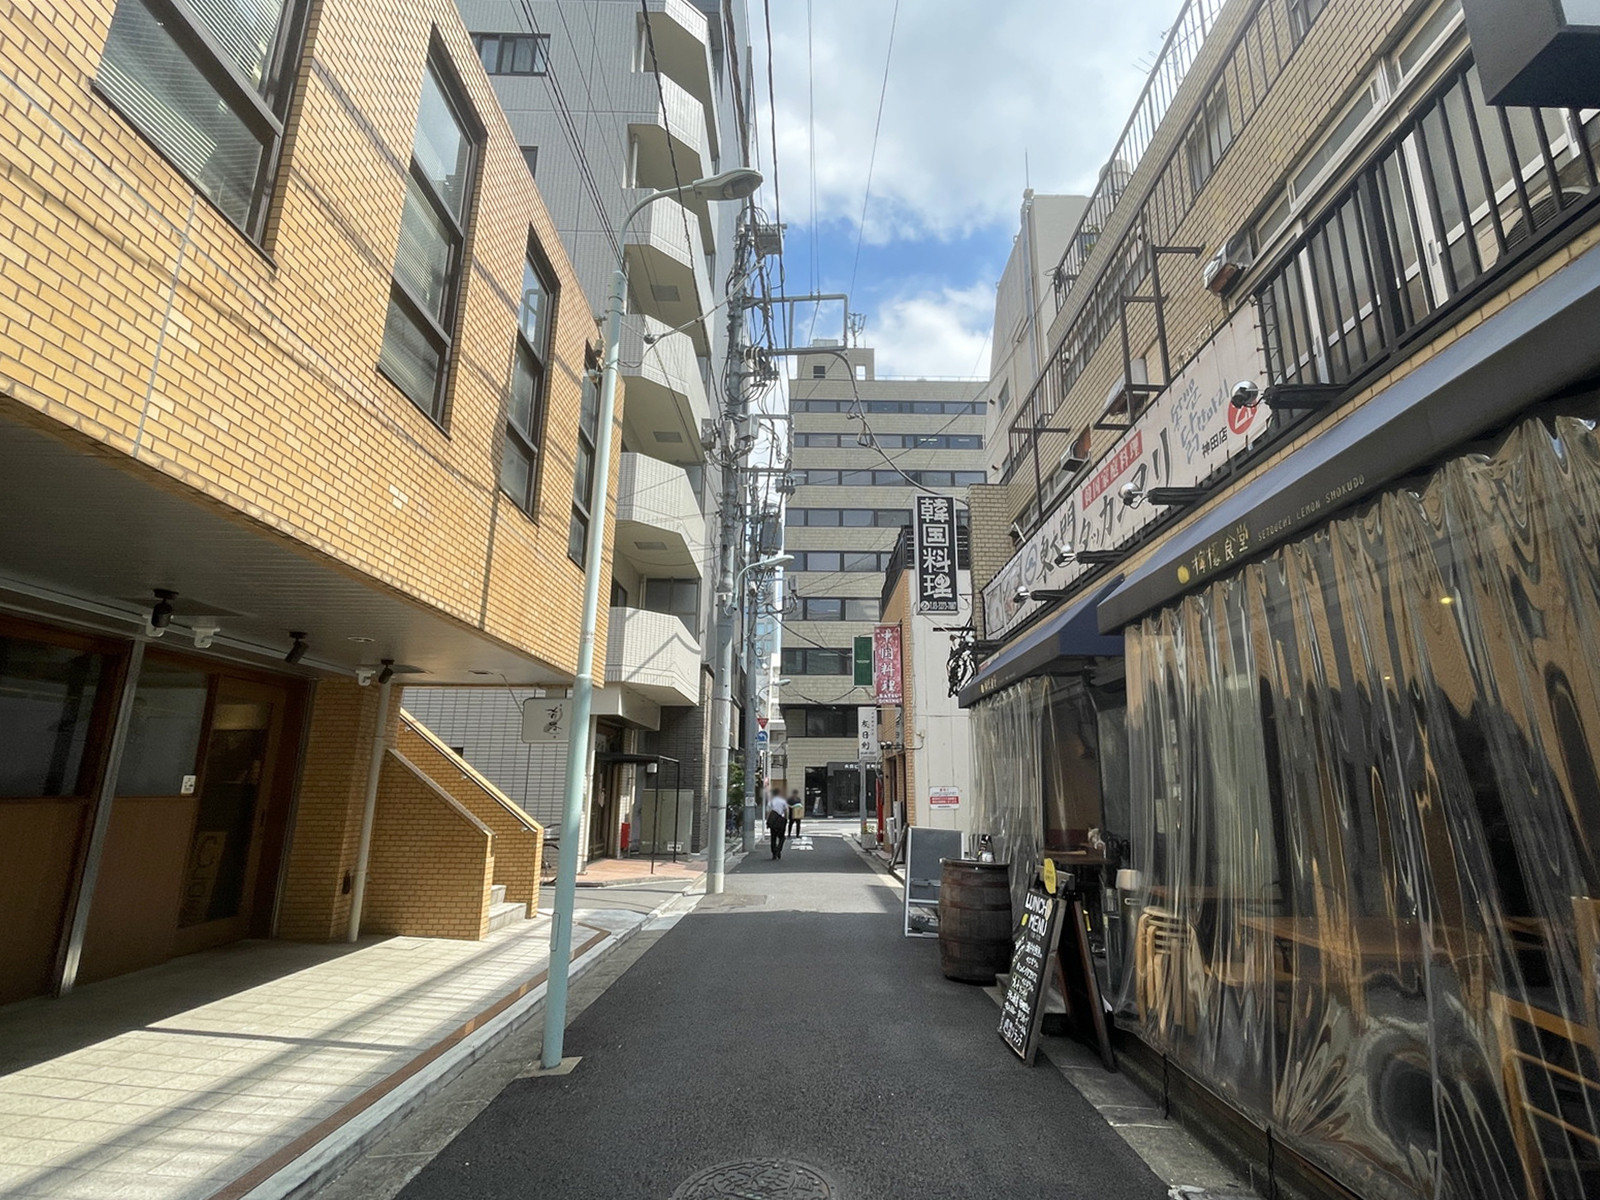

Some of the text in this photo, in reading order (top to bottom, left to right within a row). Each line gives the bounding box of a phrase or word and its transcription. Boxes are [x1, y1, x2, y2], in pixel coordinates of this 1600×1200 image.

[1202, 426, 1228, 458] 神田店
[1296, 502, 1321, 520] LEMON
[1325, 474, 1365, 504] SHOKUDO
[920, 498, 953, 598] 韓国料理
[1024, 892, 1048, 916] LUNCH
[1028, 913, 1048, 936] MENU
